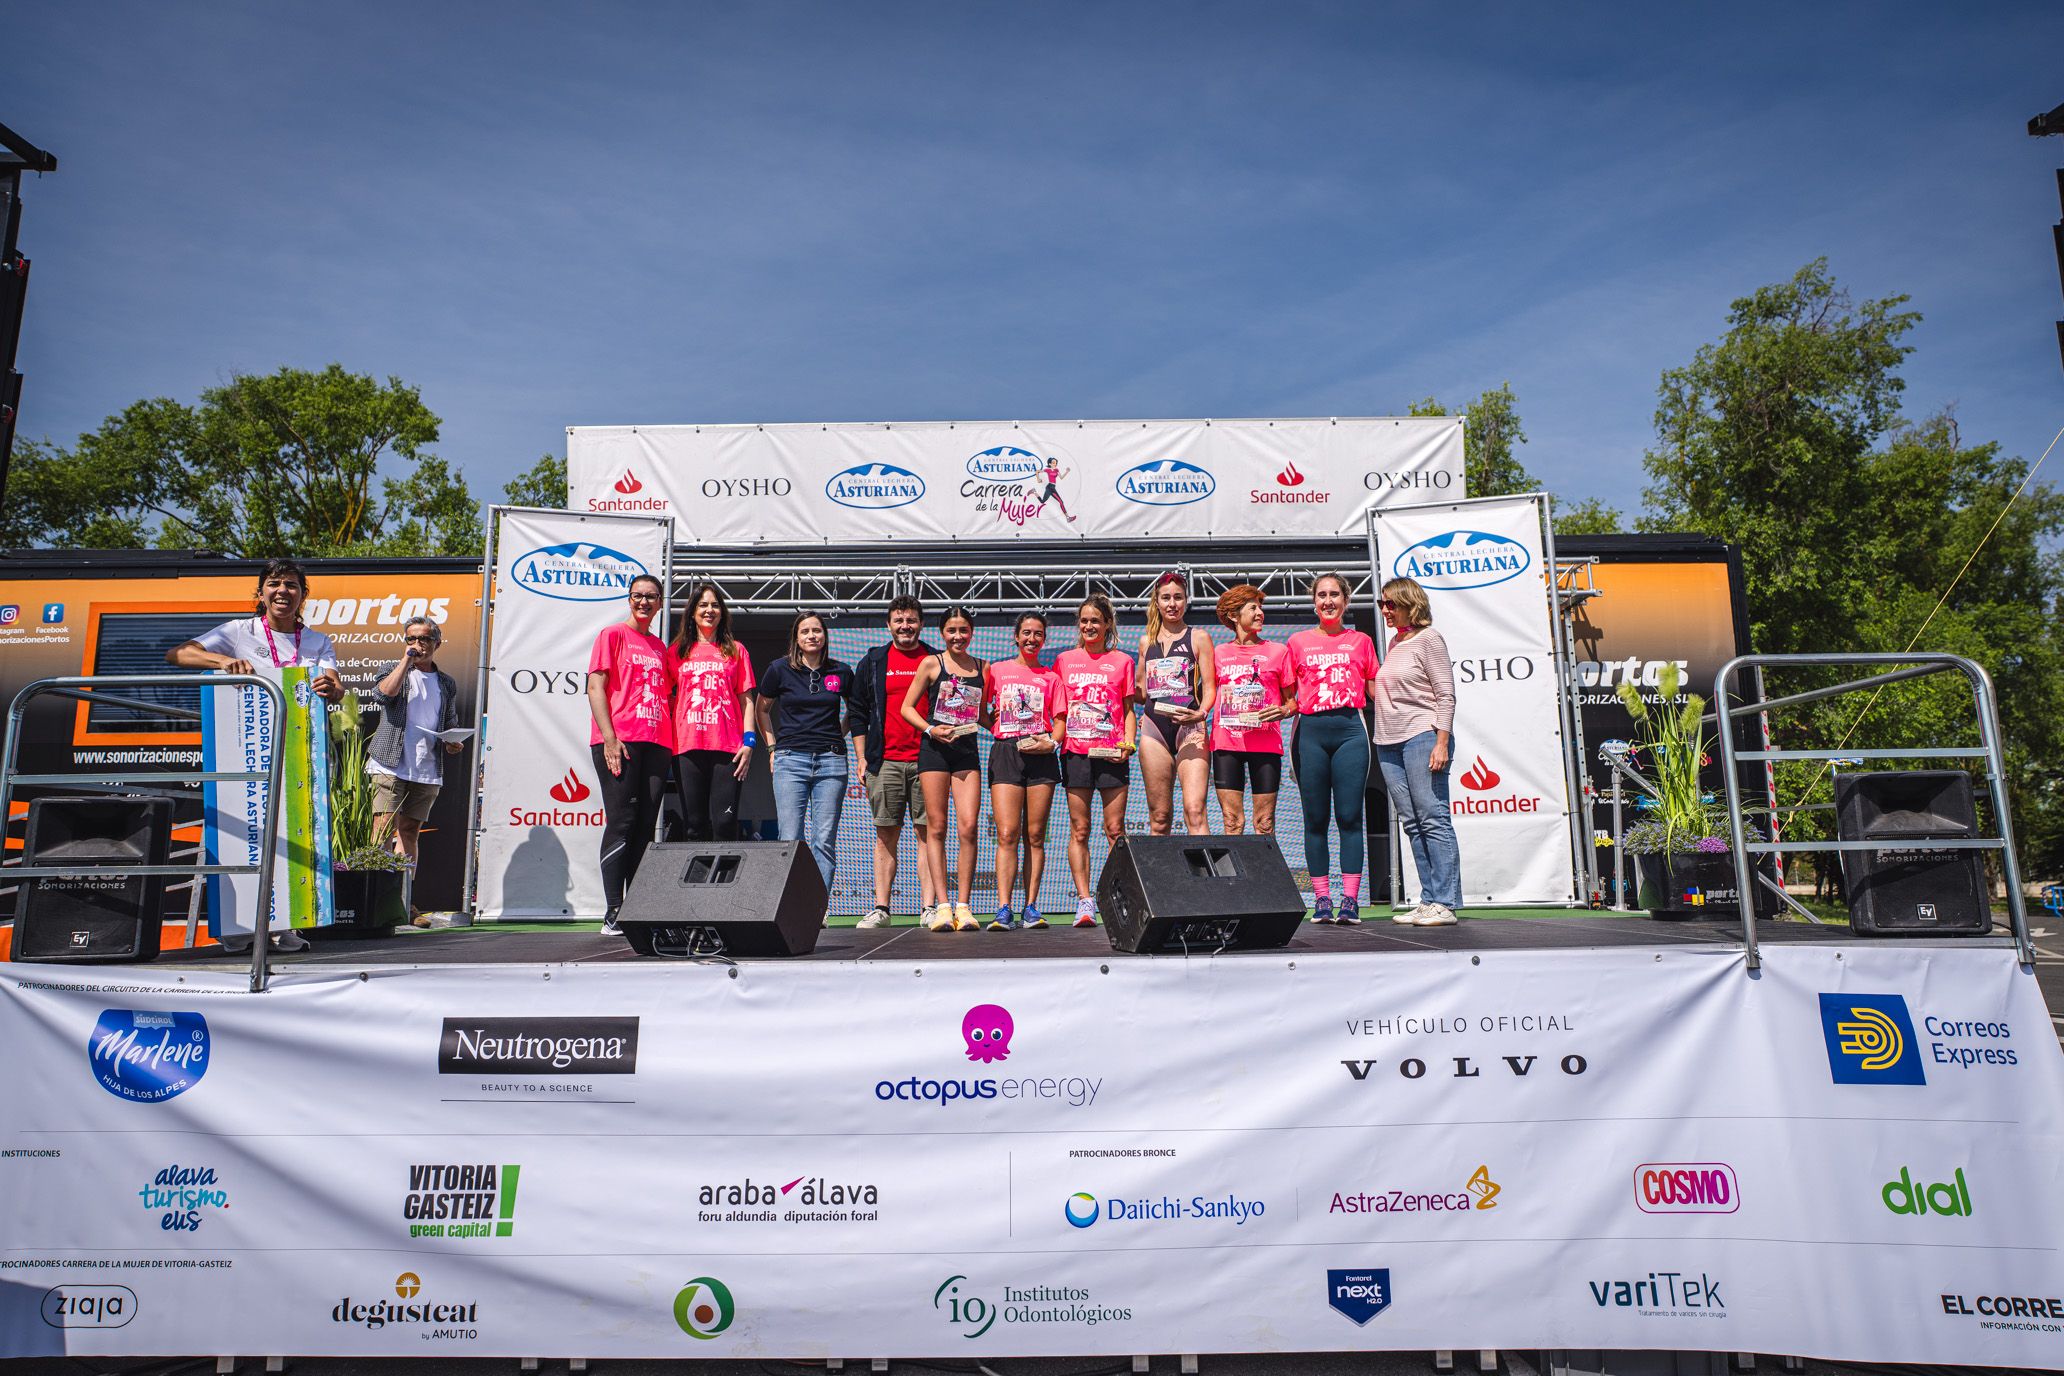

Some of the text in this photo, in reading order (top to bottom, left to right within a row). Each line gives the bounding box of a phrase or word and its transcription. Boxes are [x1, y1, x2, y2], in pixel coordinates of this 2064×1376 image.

[973, 460, 1037, 472] ASTURIANA
[702, 478, 792, 498] OYSHO
[834, 480, 918, 497] ASTURIANA
[960, 480, 1023, 497] Carrera
[1124, 477, 1208, 494] ASTURIANA
[1364, 470, 1451, 490] OYSHO
[589, 498, 668, 512] Santander
[976, 499, 998, 511] de la
[1250, 490, 1330, 503] Santander
[997, 496, 1046, 526] Mujer
[1424, 546, 1515, 559] CENTRAL LECHERA
[545, 560, 635, 571] CENTRAL LECHERA
[1405, 555, 1520, 578] ASTURIANA
[348, 657, 359, 667] de
[683, 662, 724, 672] CARRERA
[1306, 653, 1350, 666] CARRERA
[1450, 656, 1534, 683] SHO
[339, 673, 361, 682] imas
[1068, 673, 1108, 685] CARRERA
[244, 685, 255, 739] CENTRAL
[688, 712, 718, 725] MUJER
[246, 742, 256, 797] LECHRA
[1450, 794, 1540, 814] ntander
[1876, 855, 1959, 863] SONORIZACIONES
[18, 982, 85, 991] PATROCINADORES
[1347, 1015, 1574, 1036] VEHÍCULO OFICIAL
[1925, 1016, 2010, 1038] Correos
[95, 1029, 203, 1077] Marlene
[452, 1030, 622, 1068] Neutrogena
[1932, 1043, 2018, 1069] Express
[1341, 1054, 1587, 1080] VOLVO
[103, 1074, 186, 1099] HIJA DE LOS ALPES
[875, 1077, 1102, 1106] octopus energy
[1070, 1150, 1142, 1158] PATROCINADORES
[155, 1165, 218, 1185] alava
[410, 1165, 497, 1190] VITORIA
[699, 1177, 878, 1205] araba álava
[1643, 1170, 1730, 1204] COSMO
[1882, 1166, 1972, 1216] dial
[404, 1193, 495, 1220] GASTEIZ
[1108, 1195, 1264, 1224] Daiichi-Sankyo
[1330, 1192, 1470, 1213] AstraZeneca
[161, 1210, 202, 1231] eus
[698, 1210, 878, 1223] foru aldundia diputación foral
[410, 1222, 492, 1239] green capital
[1004, 1285, 1089, 1302] Institutos
[1337, 1283, 1382, 1298] next
[1589, 1273, 1725, 1307] variTek
[55, 1298, 123, 1322] ziaja
[332, 1297, 479, 1329] degusteat
[949, 1286, 986, 1323] io
[1941, 1295, 1974, 1315] EL
[1004, 1304, 1132, 1326] Odontológicos
[432, 1330, 477, 1339] AMUTIO
[1980, 1322, 2061, 1332] INFORMACIÓN CON
